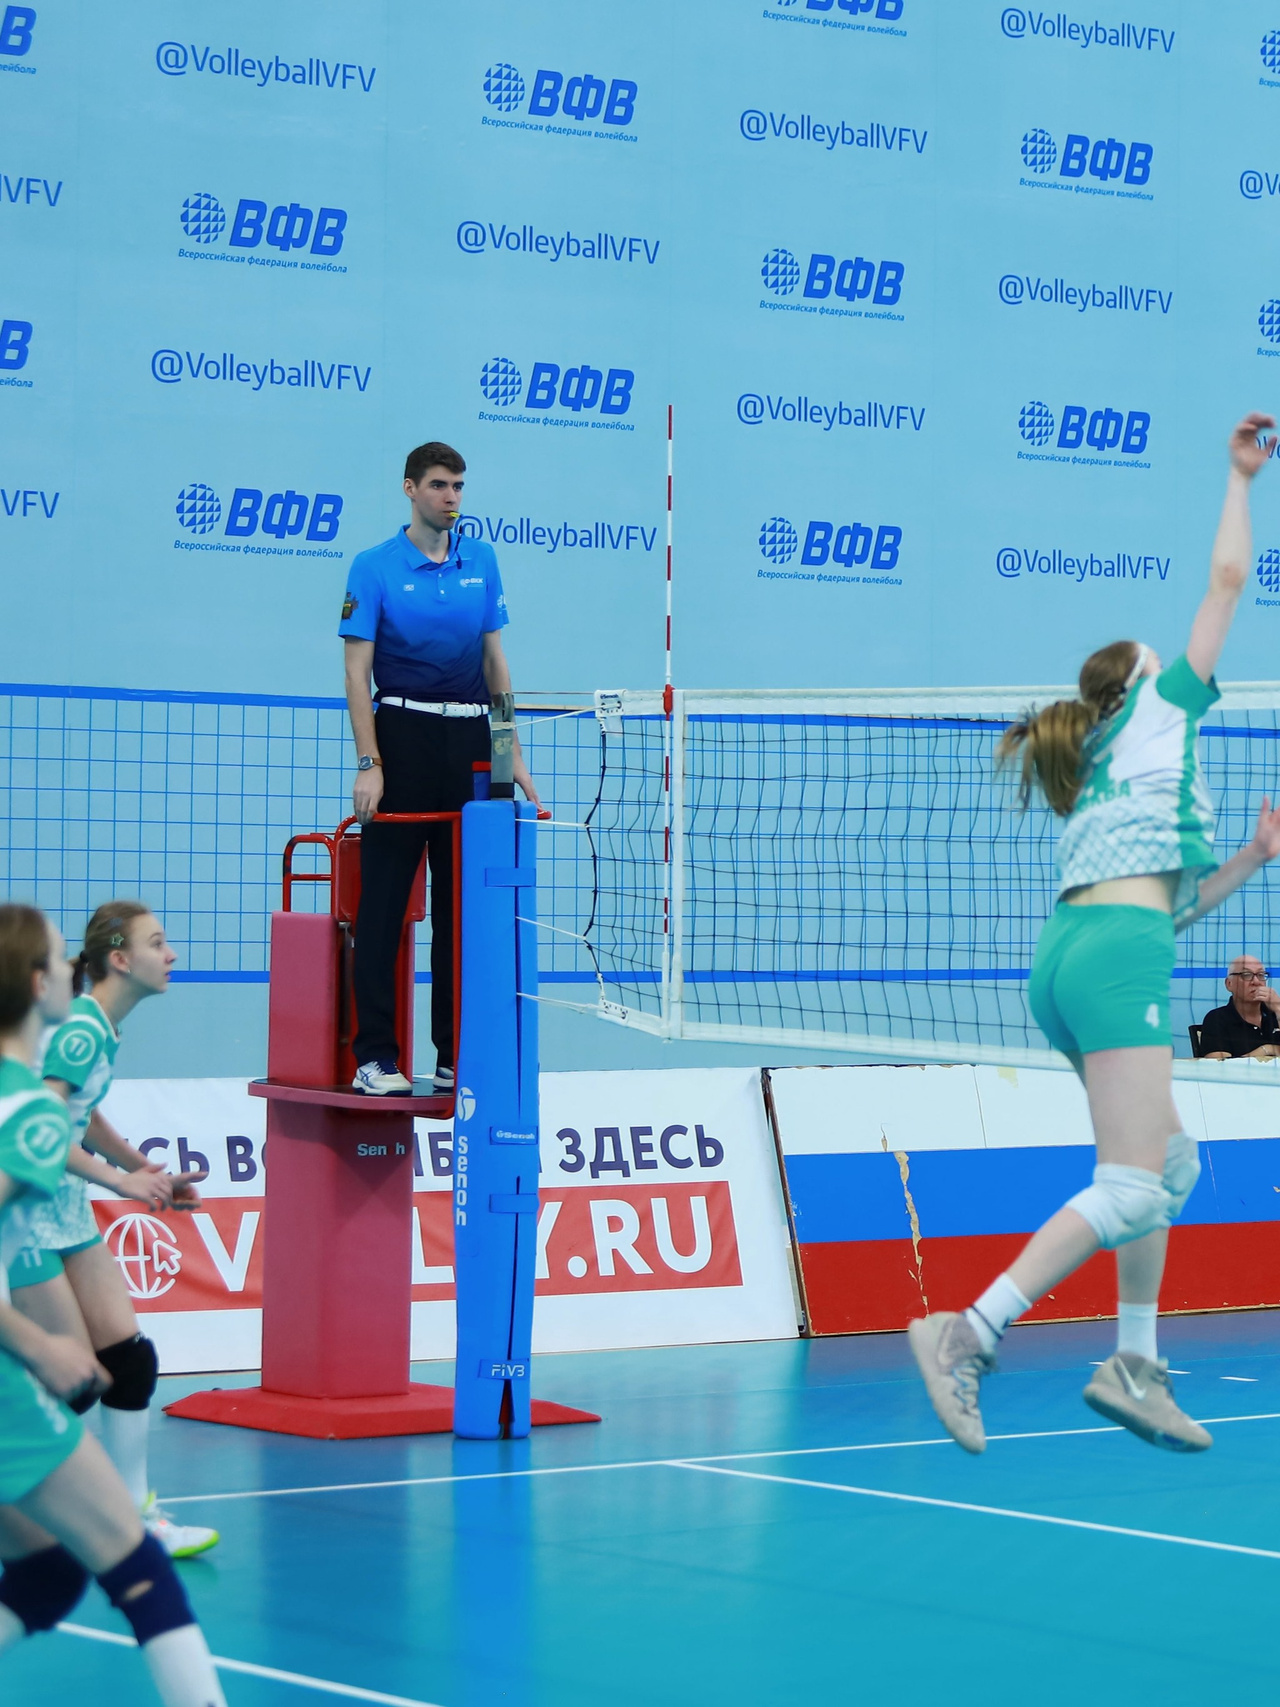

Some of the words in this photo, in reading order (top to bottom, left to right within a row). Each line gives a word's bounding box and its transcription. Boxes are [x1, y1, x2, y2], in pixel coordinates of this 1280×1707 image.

[763, 10, 820, 25] Всероссийская
[822, 19, 865, 30] федерация
[867, 26, 906, 37] волейбола
[1001, 8, 1175, 53] @VolleyballVFV
[156, 42, 376, 92] @VolleyballVFV
[528, 70, 638, 125] ВФВ
[482, 116, 543, 131] Всероссийская
[545, 125, 592, 136] федерация
[594, 132, 638, 142] волейбола
[740, 110, 927, 153] @VolleyballVFV
[1060, 134, 1153, 185] ВФВ
[1020, 178, 1073, 191] Всероссийская
[1075, 185, 1114, 195] федерация
[1117, 191, 1153, 201] волейбола
[229, 199, 347, 256] ВФВ
[457, 221, 660, 264] @VolleyballVFV
[178, 249, 245, 263] Всероссийская
[248, 256, 298, 268] федерация
[301, 263, 347, 273] волейбола
[803, 254, 904, 305] ВФВ
[760, 300, 817, 313] Всероссийская
[819, 306, 862, 317] федерация
[864, 312, 904, 321] волейбола
[999, 275, 1173, 313] @VolleyballVFV
[151, 349, 371, 391] @VolleyballVFV
[525, 362, 634, 415] ВФВ
[479, 412, 540, 424] Всероссийская
[542, 417, 589, 427] федерация
[591, 422, 634, 431] волейбола
[737, 394, 925, 431] @VolleyballVFV
[1057, 405, 1150, 454] ВФВ
[1017, 451, 1070, 462] Всероссийская
[1072, 456, 1112, 466] федерация
[1114, 460, 1151, 468] волейбола
[224, 488, 343, 542] ВФВ
[174, 540, 241, 552] Всероссийская
[243, 545, 293, 556] федерация
[296, 549, 343, 558] волейбола
[801, 521, 902, 570] ВФВ
[997, 548, 1170, 582] @VolleyballVFV
[757, 570, 815, 580] Всероссийская
[817, 573, 860, 583] федерация
[862, 576, 902, 585] волейбола
[1144, 1004, 1160, 1029] 4
[357, 1142, 406, 1157] Senh
[556, 1124, 725, 1179] ЗДЕСЬ
[456, 1135, 469, 1226] Senoh
